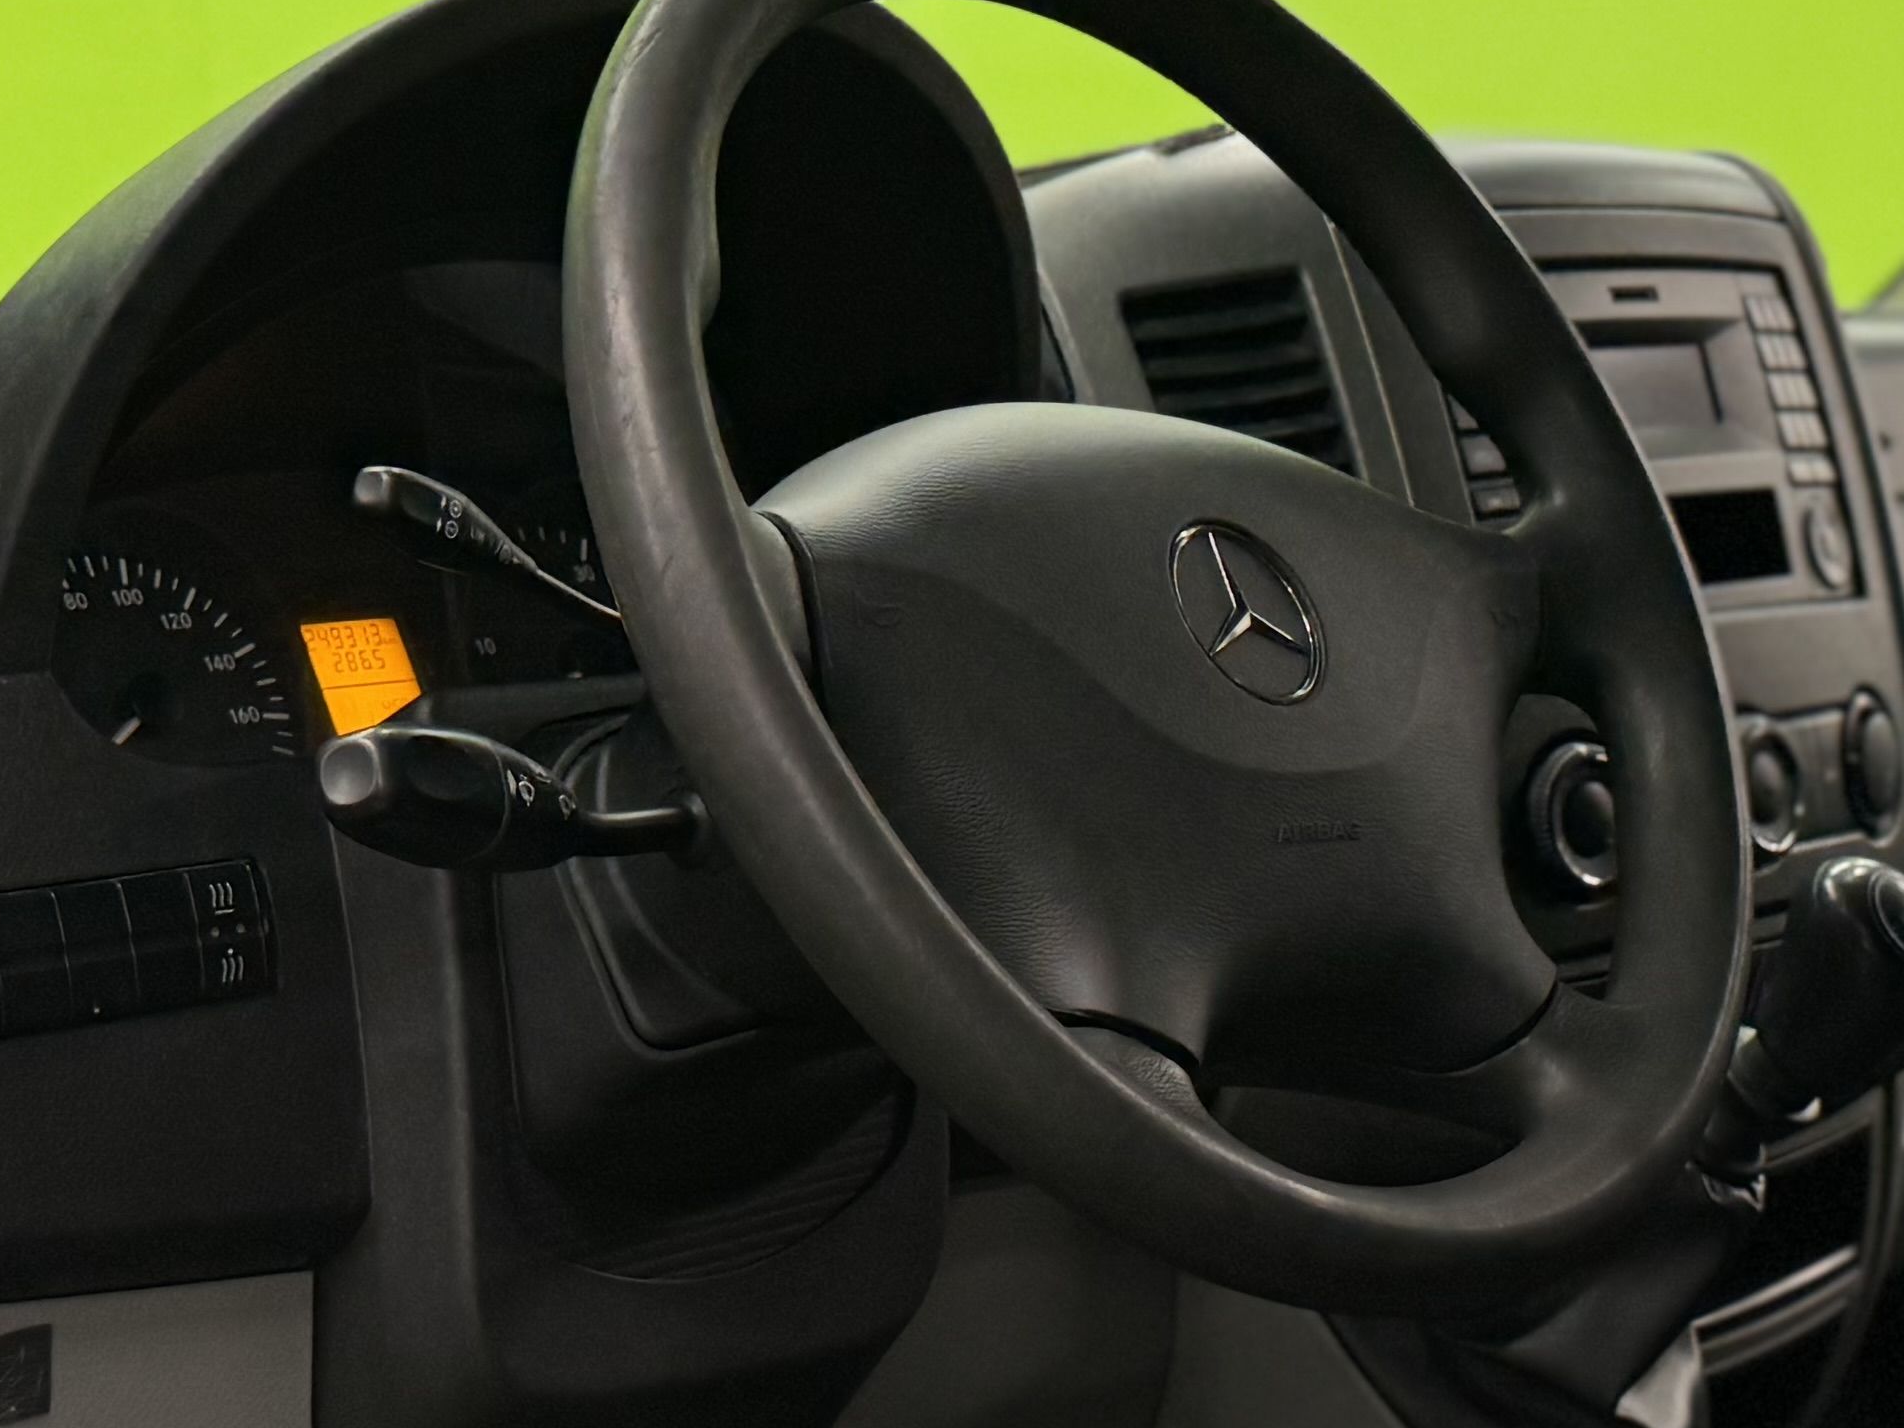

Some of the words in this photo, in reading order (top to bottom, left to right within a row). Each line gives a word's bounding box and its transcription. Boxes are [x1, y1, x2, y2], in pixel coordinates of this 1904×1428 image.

[63, 592, 88, 611] 80
[111, 588, 144, 607] 100
[160, 612, 193, 631] 120
[303, 623, 382, 651] 249313
[475, 637, 496, 656] 10
[203, 653, 236, 673] 140
[332, 649, 385, 673] 2865
[229, 705, 261, 725] 160
